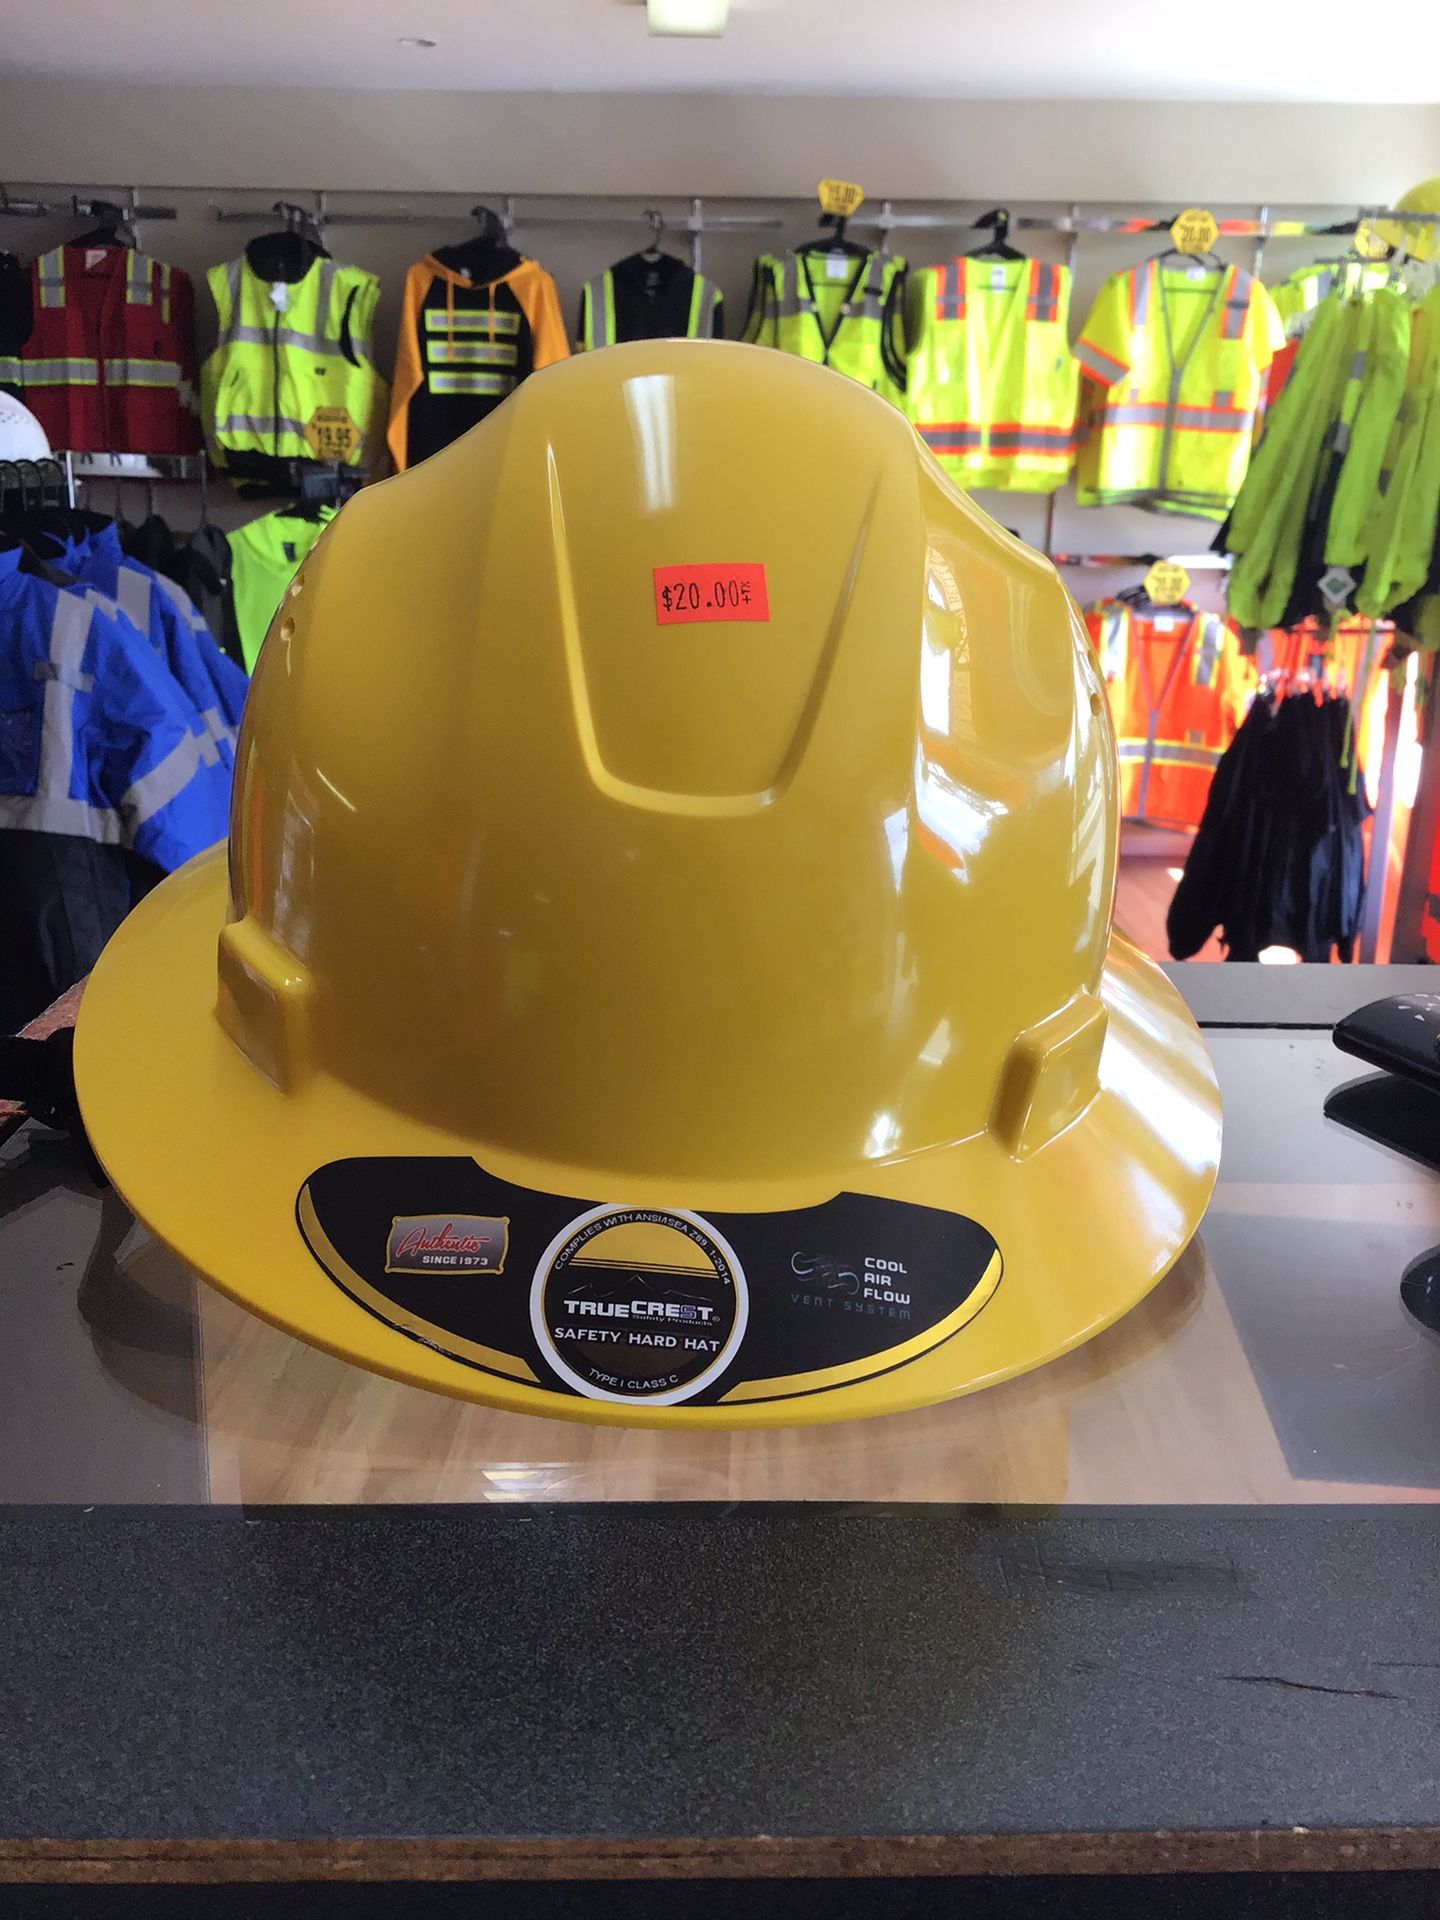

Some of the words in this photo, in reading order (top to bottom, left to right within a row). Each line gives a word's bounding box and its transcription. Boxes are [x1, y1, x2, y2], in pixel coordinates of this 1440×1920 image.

[661, 580, 739, 612] $20.00
[395, 1221, 492, 1258] Authentic
[554, 1222, 602, 1270] COMPLIES
[603, 1213, 633, 1228] WITH
[422, 1255, 457, 1266] SINCE
[459, 1256, 489, 1266] 1973
[864, 1257, 908, 1274] COOL
[864, 1272, 892, 1287] AIR
[790, 1293, 834, 1308] VENT
[863, 1287, 910, 1305] FLOW
[843, 1300, 911, 1320] SYSTEM
[632, 1314, 665, 1322] Safety
[667, 1317, 713, 1327] Products
[554, 1326, 622, 1344] SAFETY
[628, 1333, 677, 1348] HARD
[684, 1338, 720, 1352] HAT
[589, 1368, 619, 1387] TYPE
[627, 1379, 667, 1390] CLASS
[669, 1374, 679, 1383] C
